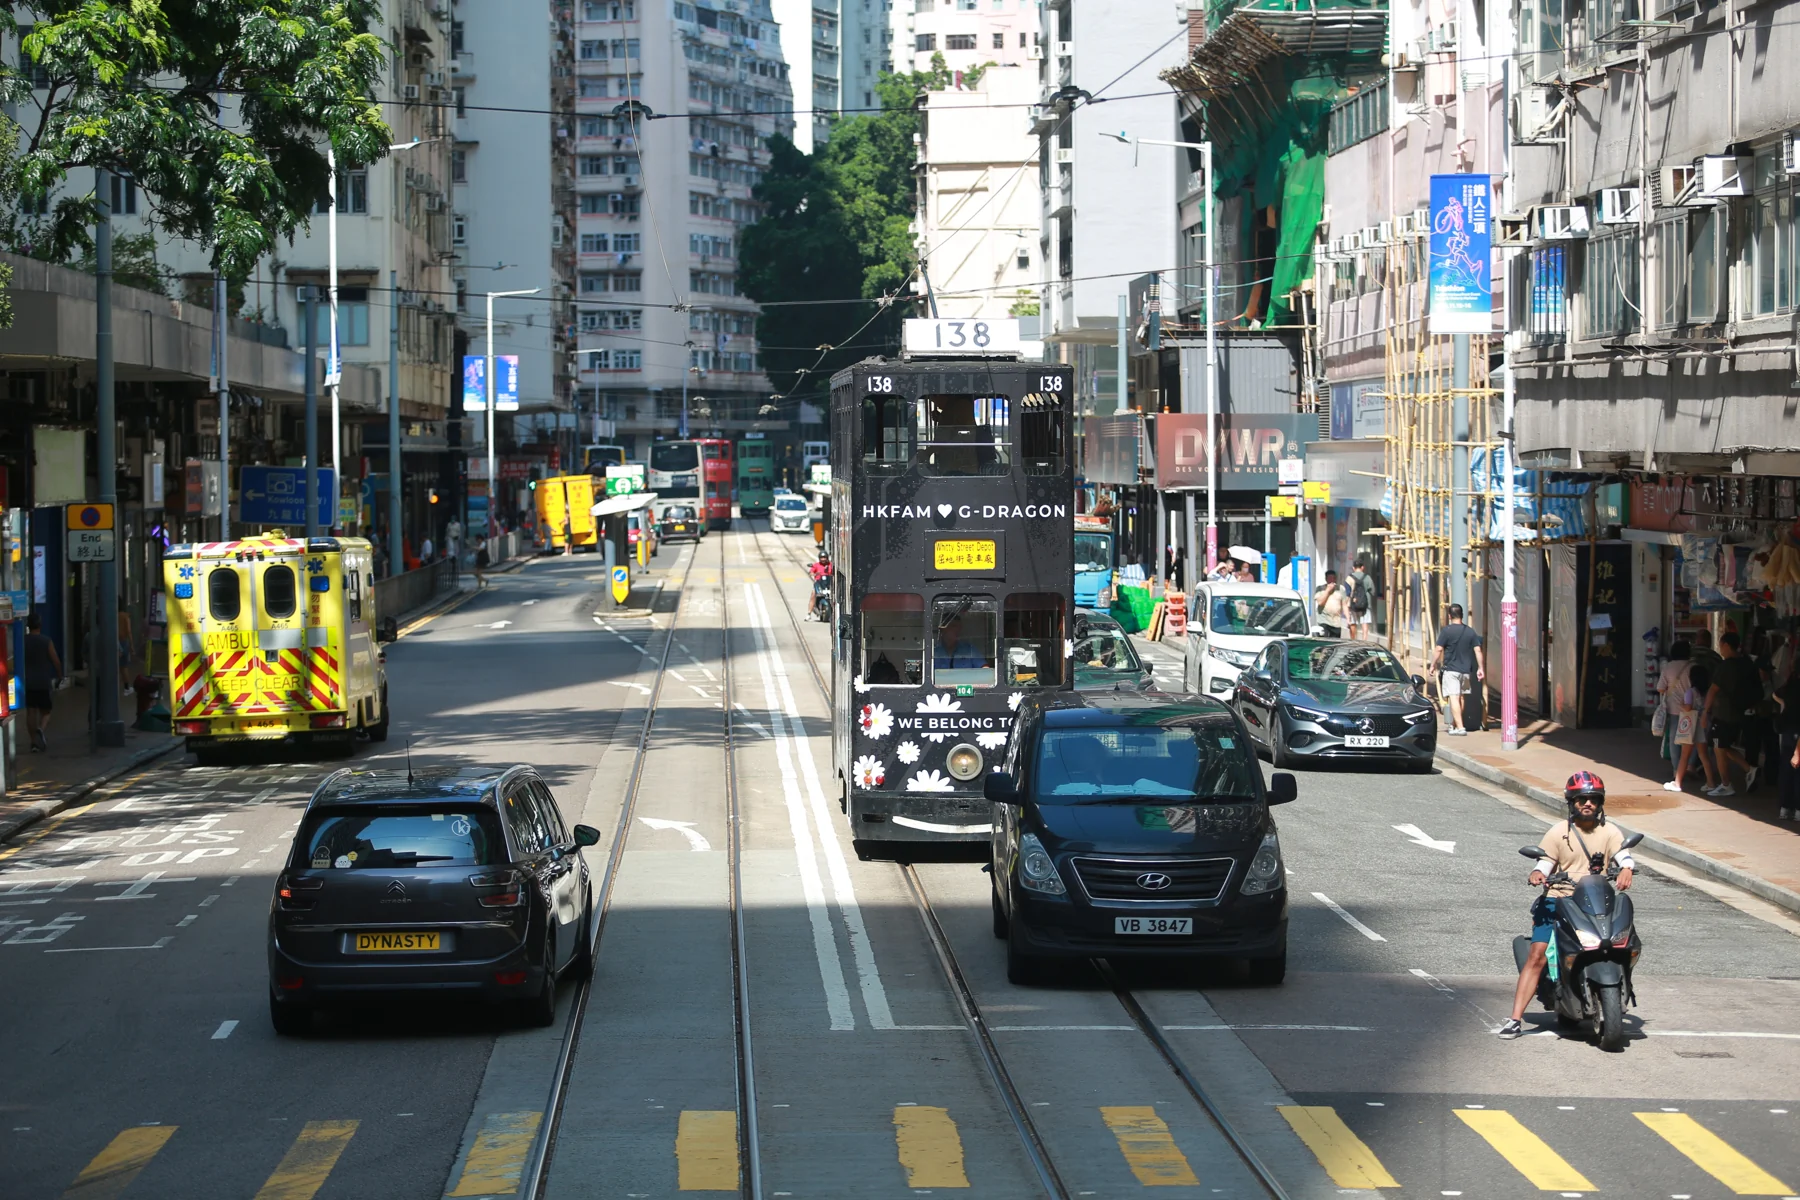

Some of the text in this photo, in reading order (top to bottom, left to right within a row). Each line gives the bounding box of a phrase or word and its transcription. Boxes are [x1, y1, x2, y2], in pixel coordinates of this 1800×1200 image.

[936, 322, 990, 348] 138
[868, 376, 892, 392] 138
[1040, 376, 1063, 391] 138
[267, 495, 304, 504] Kowloon
[863, 504, 1066, 519] HKFAM G-DRAGON
[81, 533, 102, 543] End
[77, 545, 105, 557] 終止
[936, 541, 994, 553] Whitty Street Depot
[212, 676, 301, 692] KEEP CLEAR
[957, 686, 972, 695] 104
[898, 718, 923, 729] WE
[928, 717, 994, 729] BELONG
[1349, 737, 1384, 746] RX 220
[55, 830, 245, 852] BUS
[1120, 919, 1189, 932] VB 3847
[360, 934, 437, 948] DYNASTY
